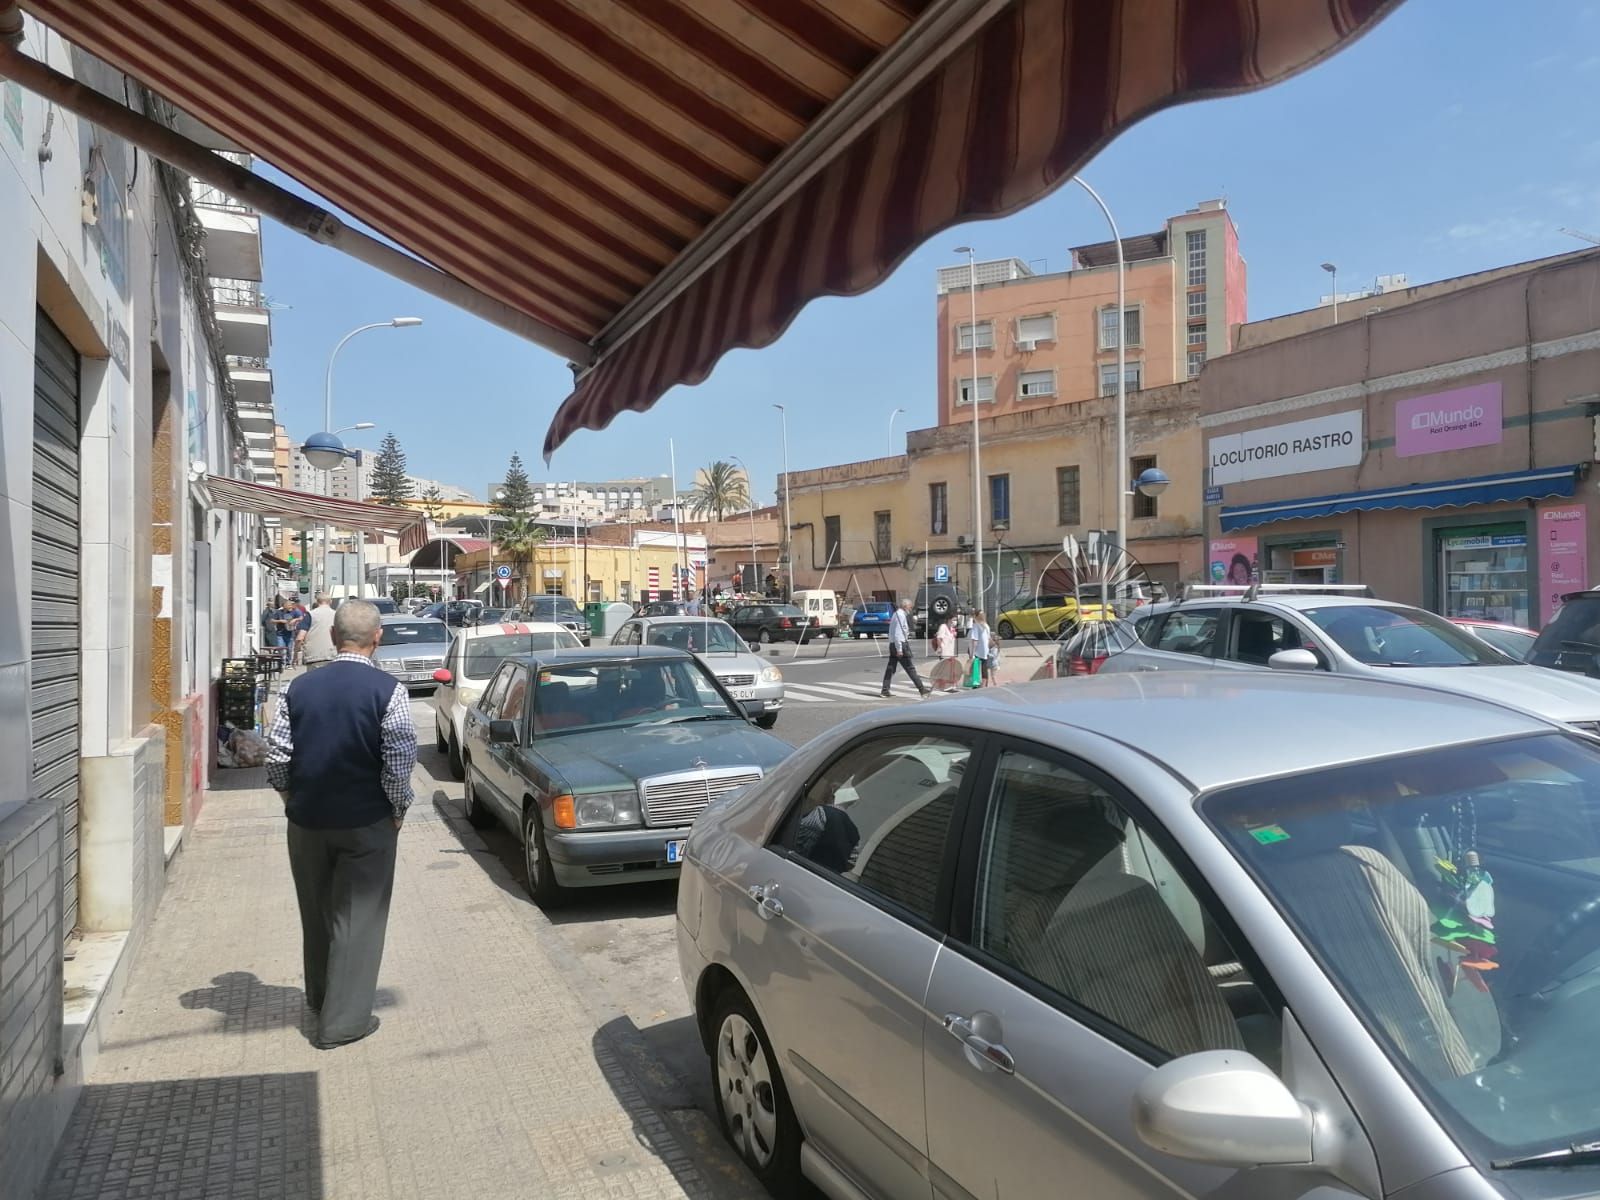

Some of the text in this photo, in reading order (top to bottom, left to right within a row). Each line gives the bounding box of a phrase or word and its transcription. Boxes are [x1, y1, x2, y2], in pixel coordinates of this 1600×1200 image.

[1431, 404, 1484, 426] Mundo
[1444, 422, 1467, 432] Orange
[1212, 430, 1354, 468] LOCUTORIO RASTRO
